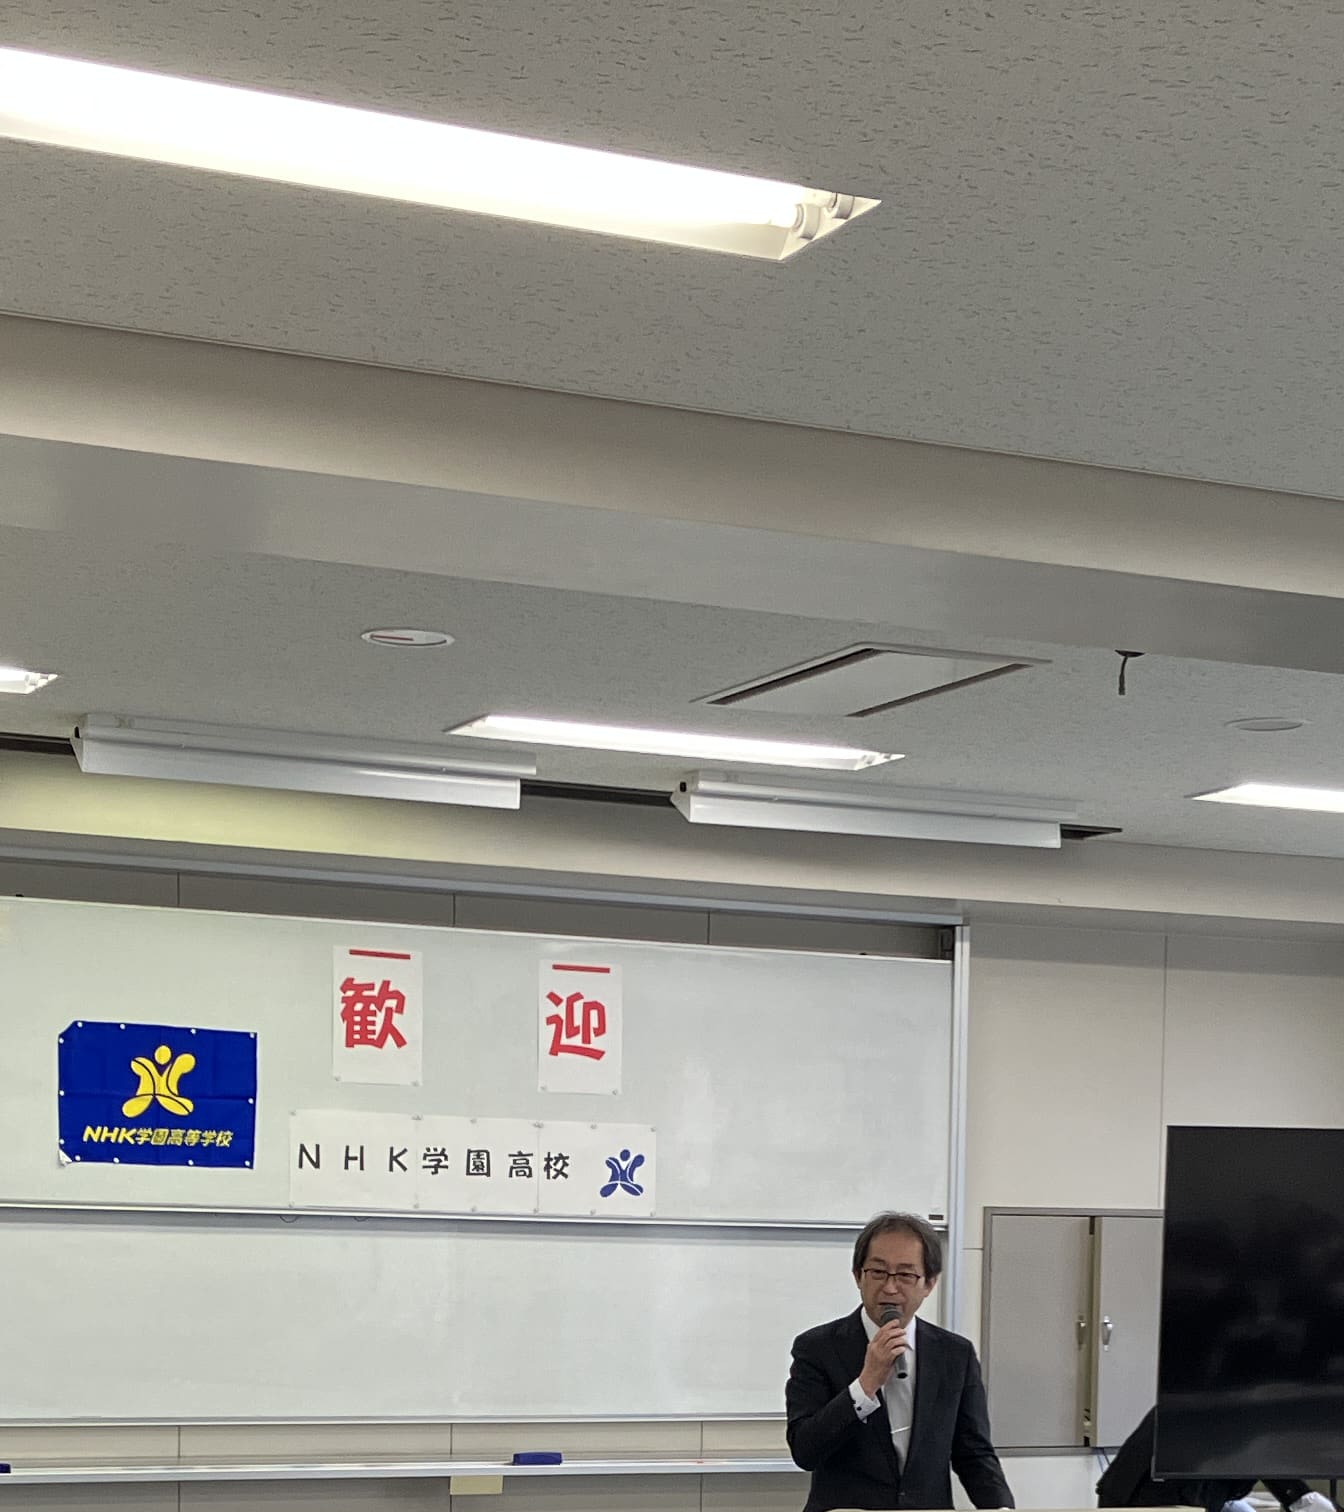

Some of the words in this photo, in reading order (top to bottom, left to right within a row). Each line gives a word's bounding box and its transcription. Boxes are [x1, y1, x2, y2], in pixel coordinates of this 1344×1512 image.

[340, 977, 407, 1049] 歓
[546, 992, 607, 1061] 迎
[83, 1125, 234, 1147] NHK学園高等学校
